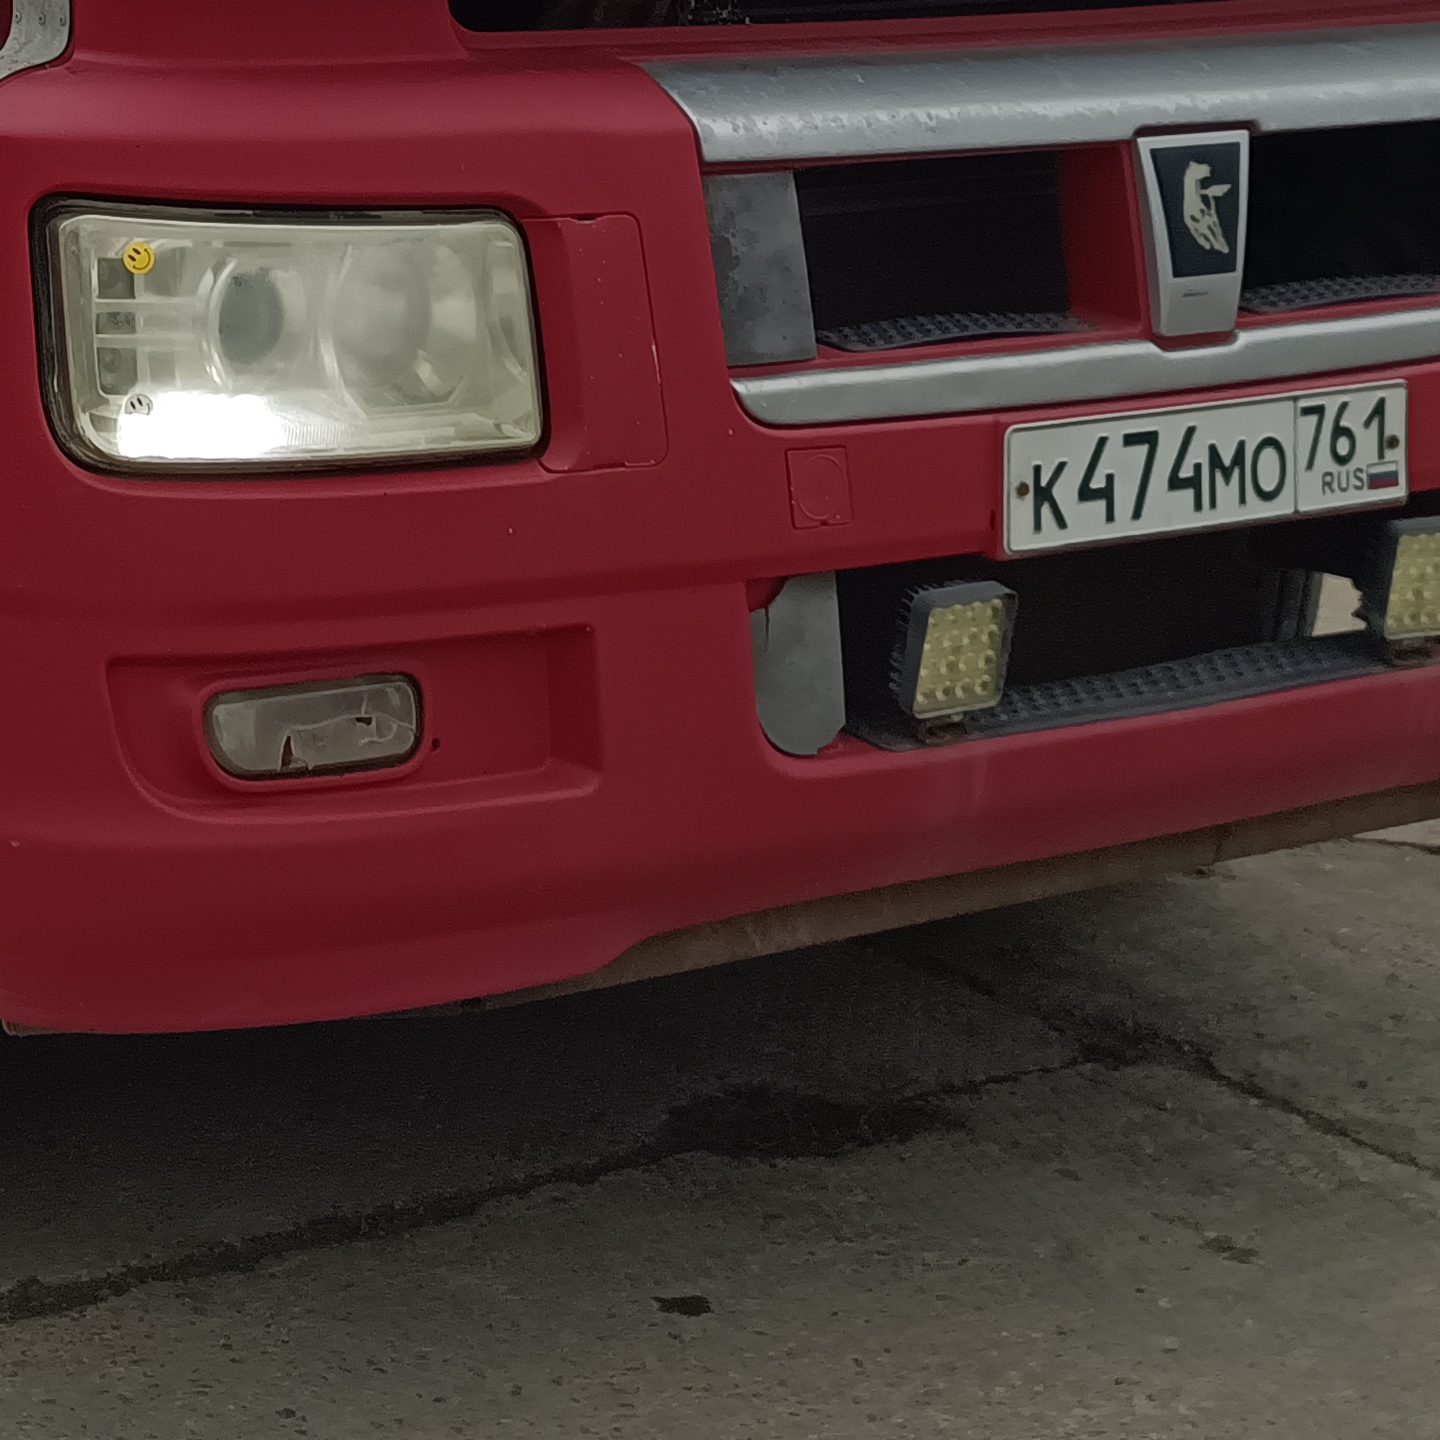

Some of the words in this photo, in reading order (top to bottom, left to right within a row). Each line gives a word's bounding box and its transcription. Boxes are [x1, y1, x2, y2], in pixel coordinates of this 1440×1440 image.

[1031, 424, 1288, 535] К474МО
[1299, 395, 1387, 473] 761
[1321, 466, 1366, 496] RUS
